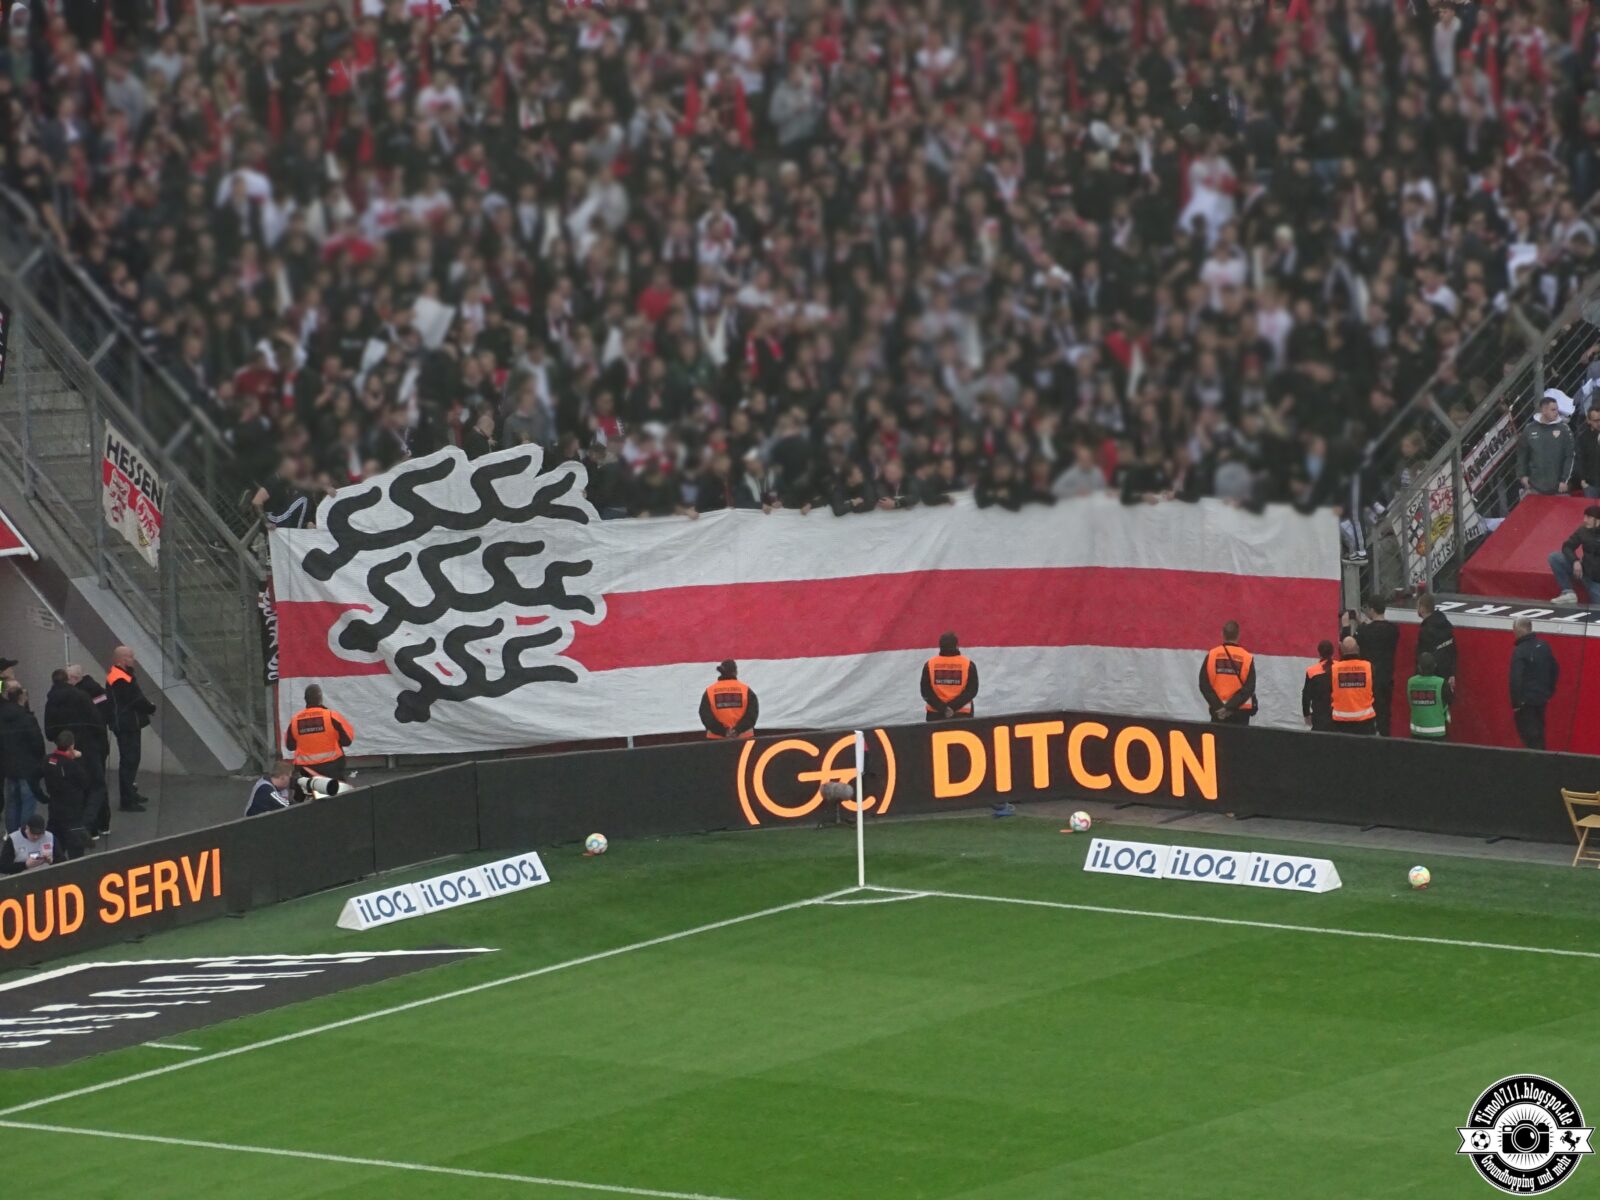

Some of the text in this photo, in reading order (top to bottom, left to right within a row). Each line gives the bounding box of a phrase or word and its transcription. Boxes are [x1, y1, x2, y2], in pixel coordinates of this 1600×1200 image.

[106, 434, 163, 511] HESSEN
[931, 720, 1218, 800] DITCON
[0, 848, 221, 950] OUD SERVI
[356, 859, 541, 923] iLOQ iLOQ iLOQ
[1091, 842, 1317, 888] iLOQ iLOQ iLOQ
